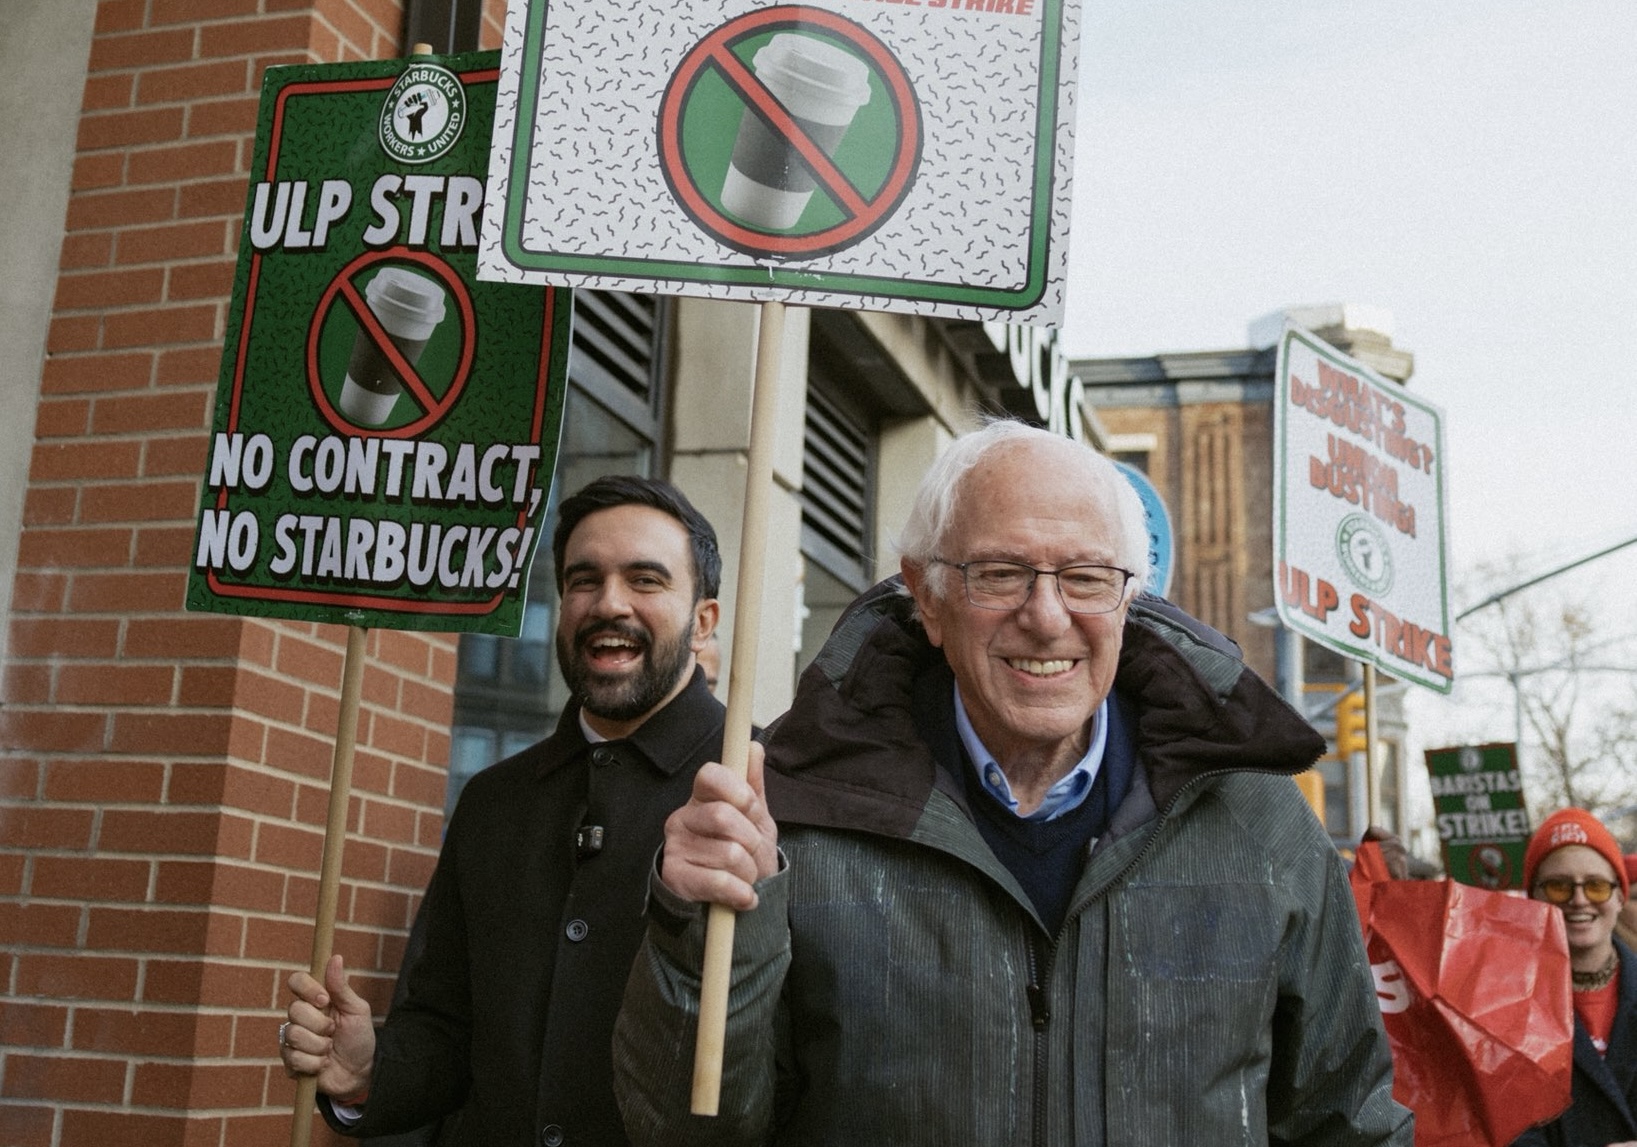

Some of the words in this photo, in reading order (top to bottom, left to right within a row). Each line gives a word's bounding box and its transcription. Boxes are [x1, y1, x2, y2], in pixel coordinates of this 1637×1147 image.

[394, 70, 458, 98] STARBUCKS
[383, 113, 415, 157] WORKERS
[428, 112, 461, 153] UNITED
[250, 176, 353, 249] ULP
[362, 174, 484, 247] STR
[209, 432, 274, 490] NO
[288, 434, 543, 518] CONTRACT,
[196, 508, 260, 571] NO
[270, 513, 535, 589] STARBUCKS!
[1279, 560, 1339, 624] ULP
[1349, 593, 1454, 681] STRIKE
[1429, 769, 1522, 796] BARISTAS
[1437, 809, 1529, 840] STRIKE!
